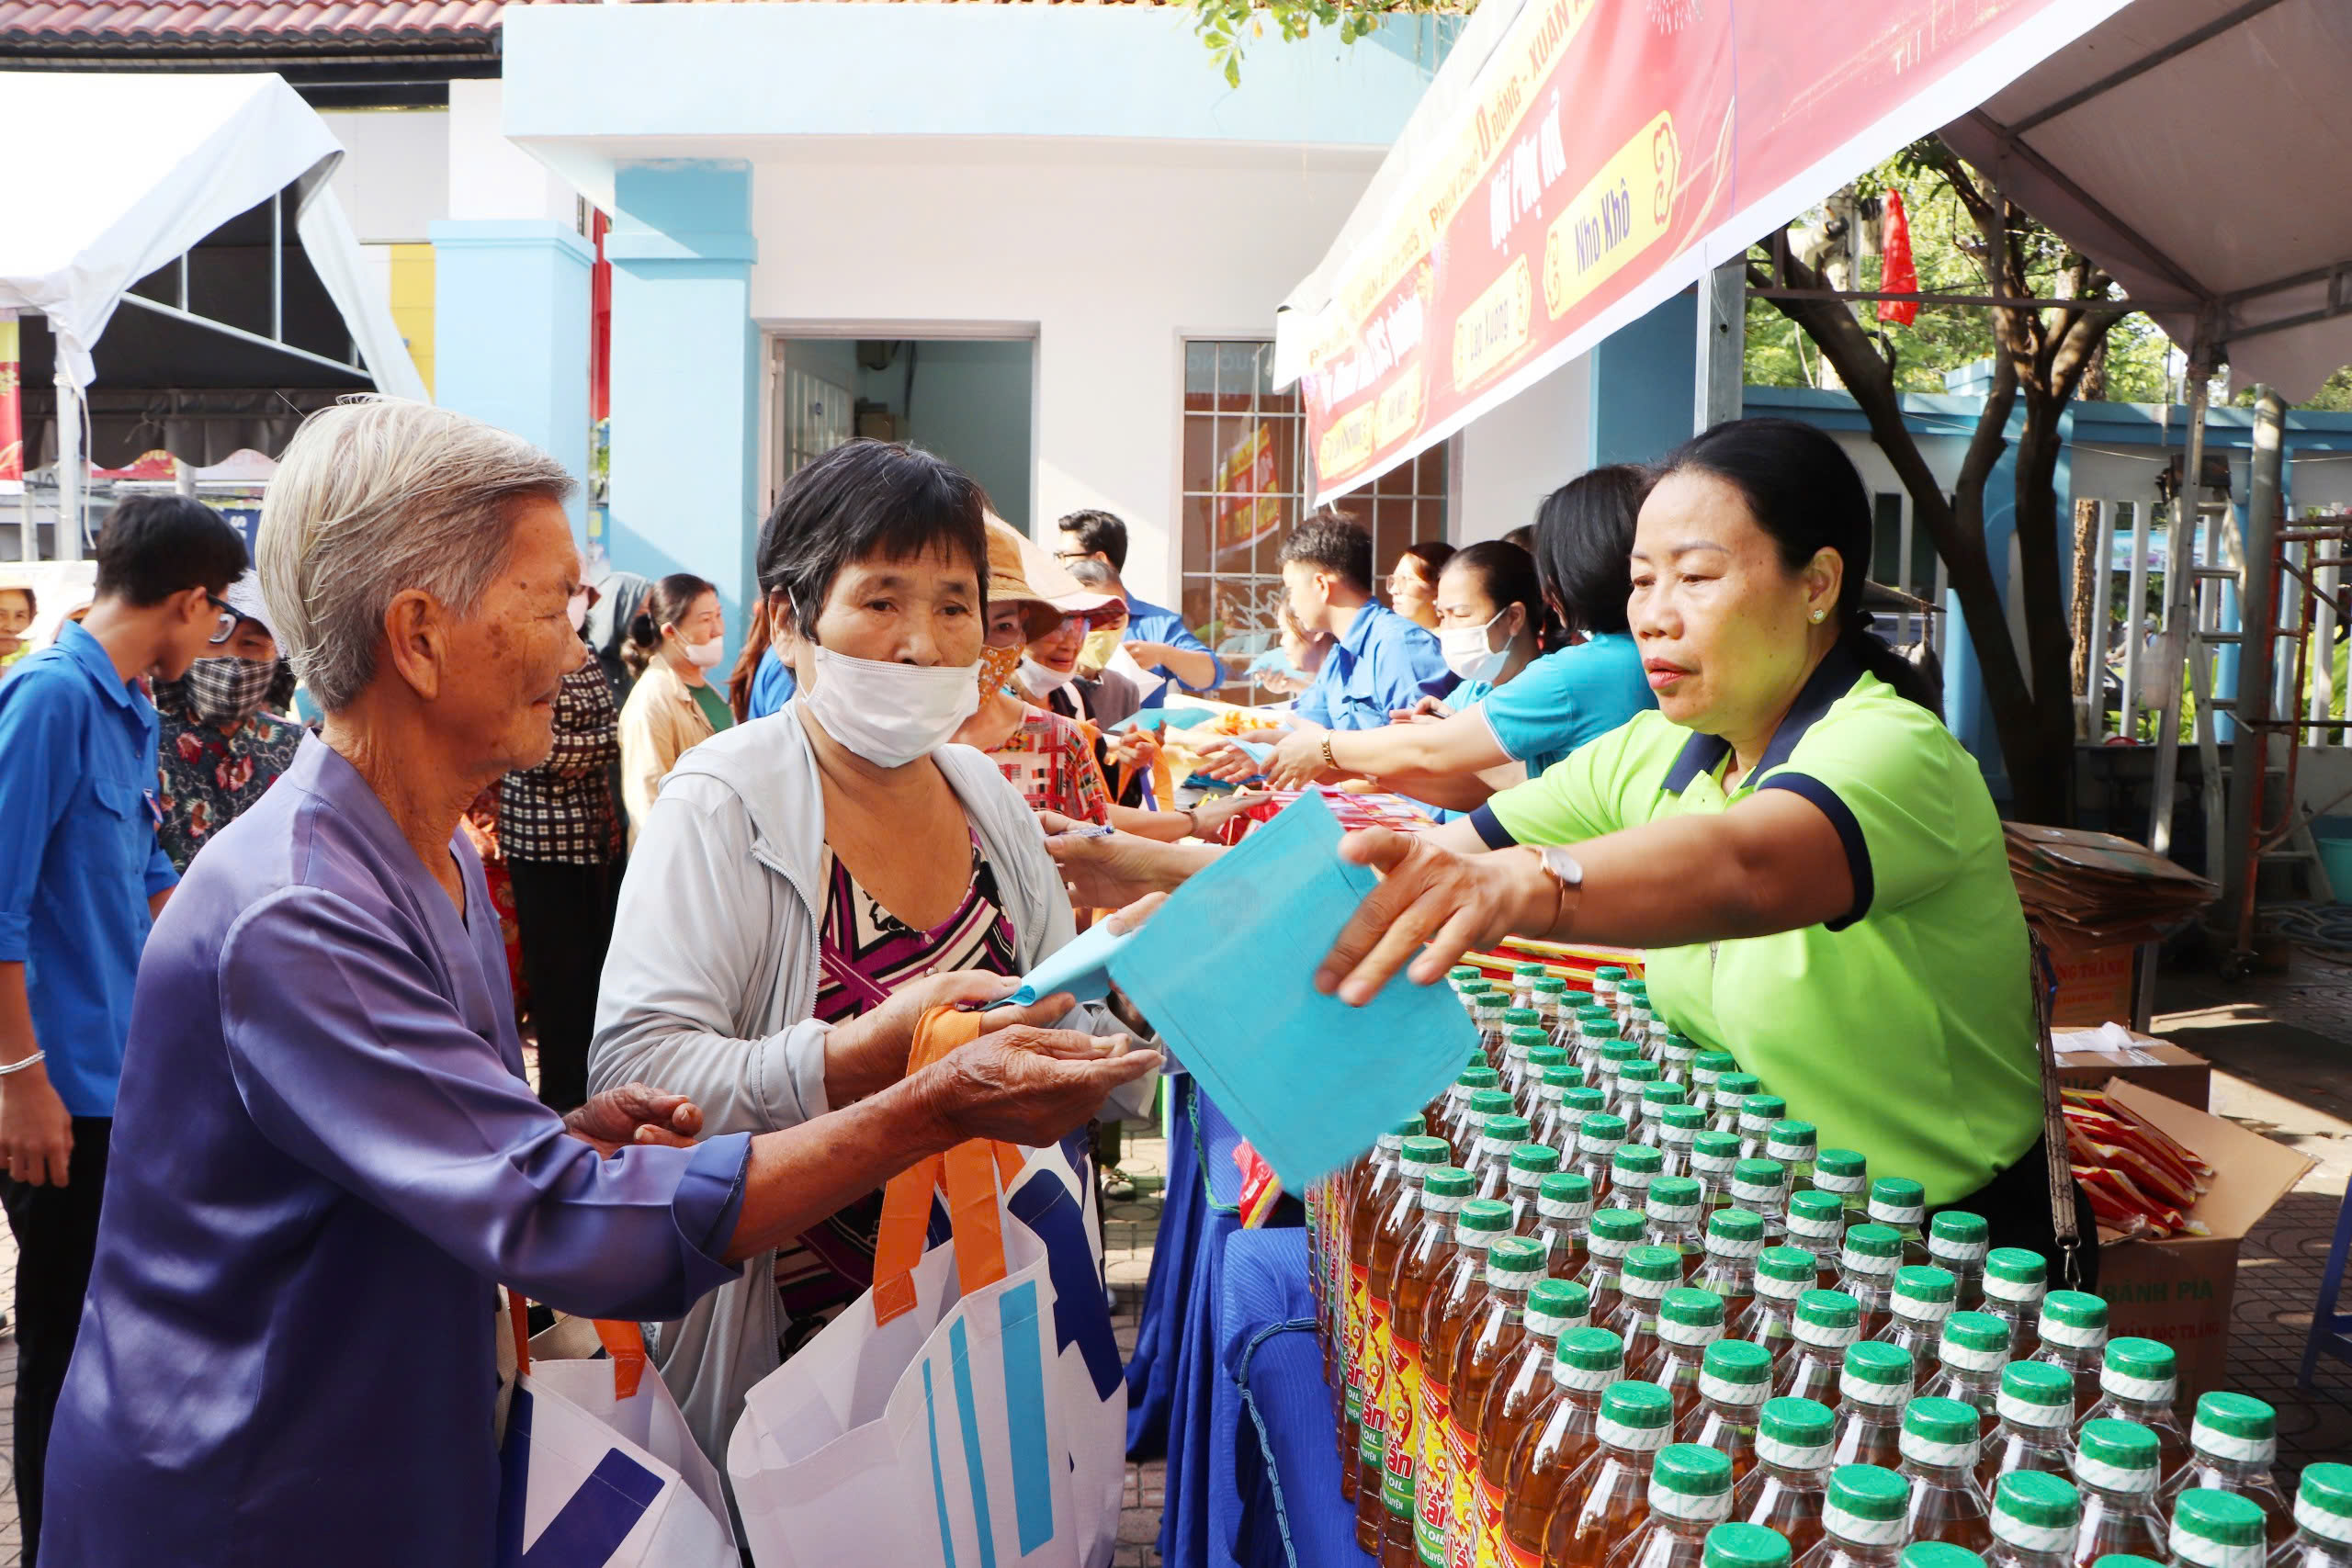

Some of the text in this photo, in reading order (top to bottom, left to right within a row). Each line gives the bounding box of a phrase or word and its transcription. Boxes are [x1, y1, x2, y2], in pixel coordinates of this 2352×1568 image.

[1575, 177, 1631, 276] Nho Khô
[1388, 1477, 1405, 1493] OIL
